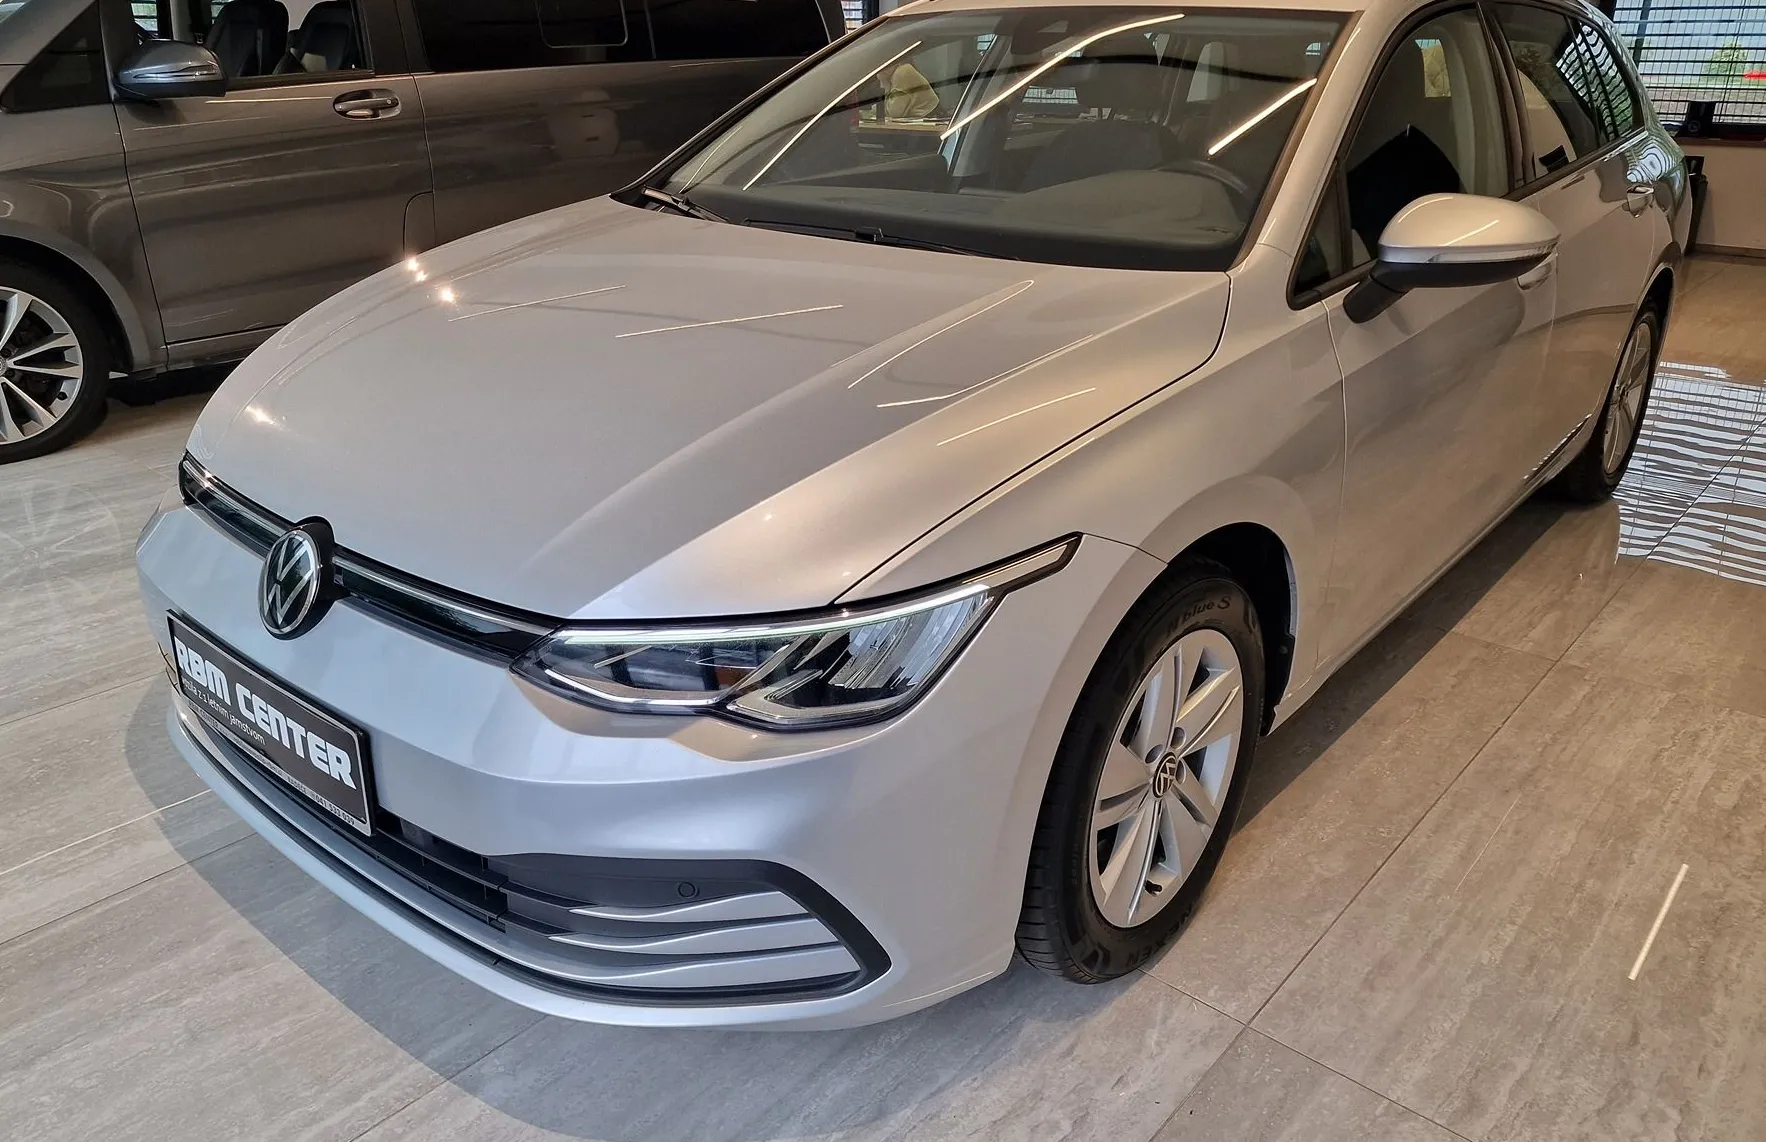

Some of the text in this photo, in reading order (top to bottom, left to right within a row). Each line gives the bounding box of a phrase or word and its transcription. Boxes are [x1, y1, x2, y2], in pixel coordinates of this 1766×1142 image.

[1182, 602, 1215, 624] blue
[1217, 595, 1231, 609] S
[174, 635, 231, 706] RBM
[235, 681, 357, 790] CENTER
[229, 710, 266, 745] jamstvom
